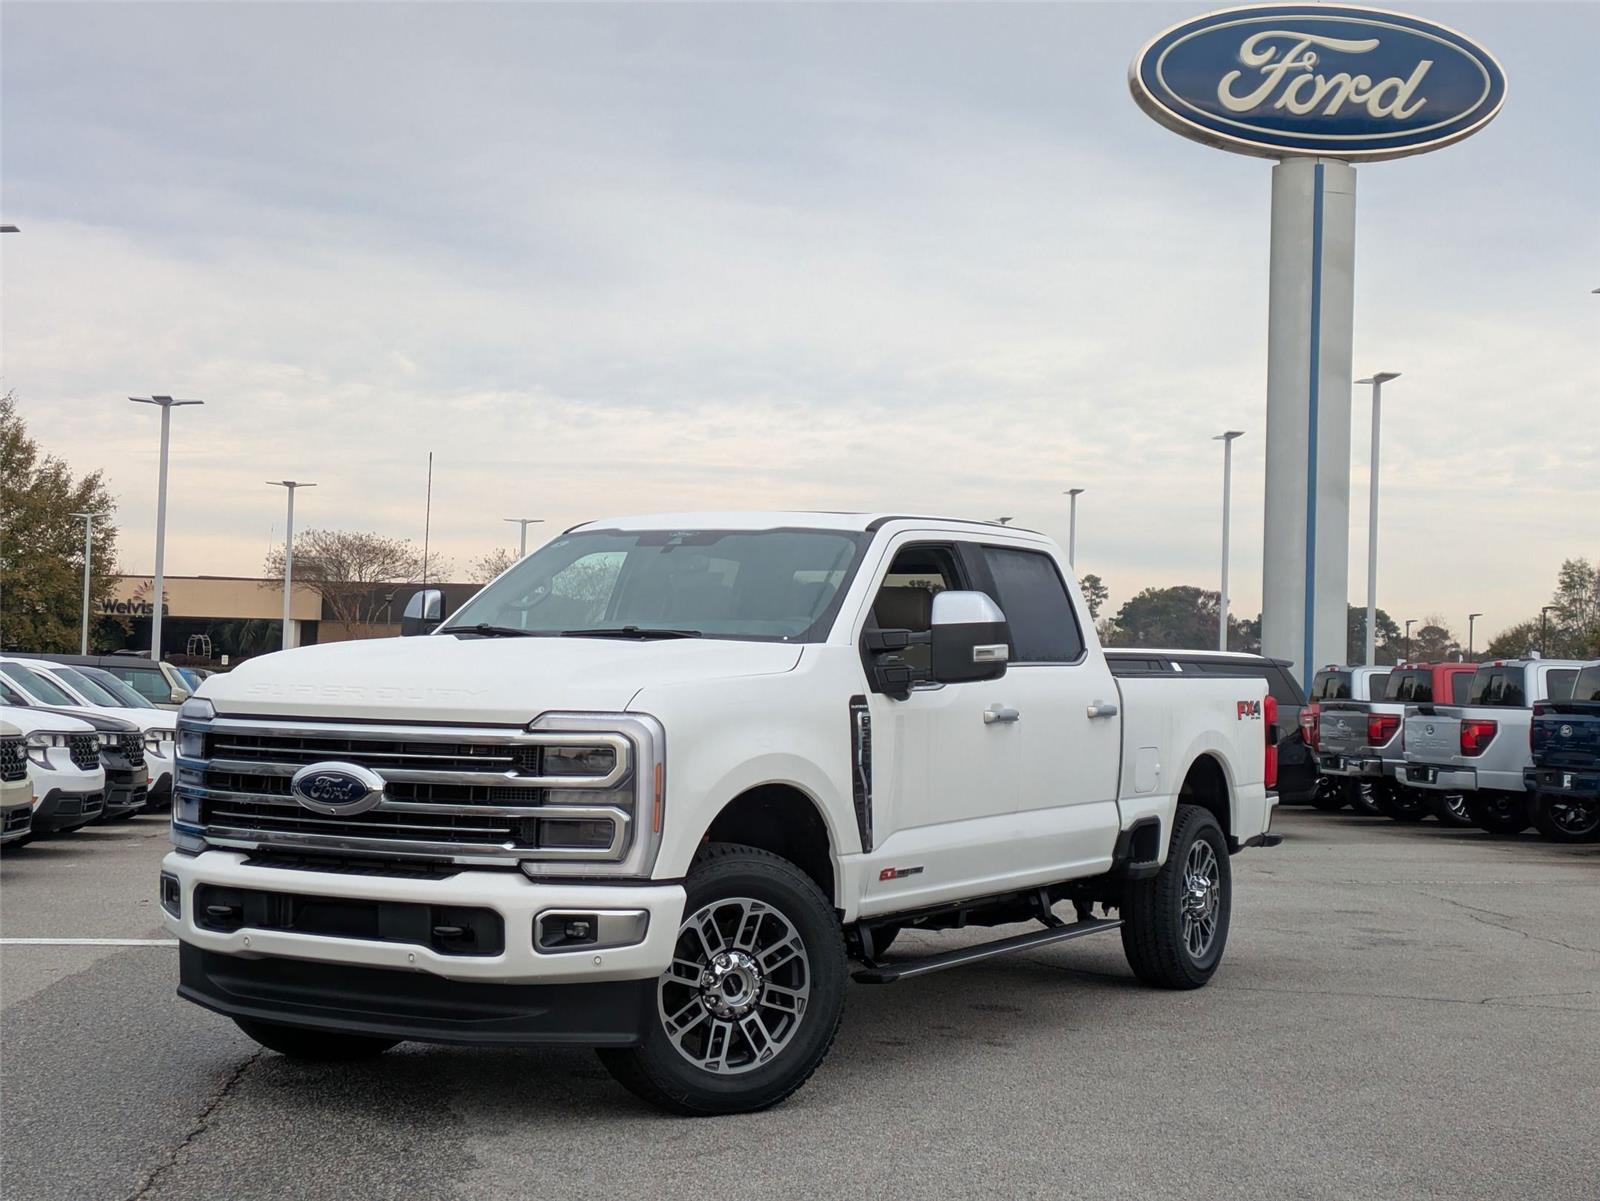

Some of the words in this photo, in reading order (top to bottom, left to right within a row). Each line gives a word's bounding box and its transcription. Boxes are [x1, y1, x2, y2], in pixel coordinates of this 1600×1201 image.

[1217, 30, 1434, 119] Ford
[102, 598, 169, 615] Welvisa
[245, 681, 369, 700] SUPER
[375, 686, 489, 703] DUTY
[1237, 700, 1261, 720] FX4
[310, 775, 353, 800] Ford
